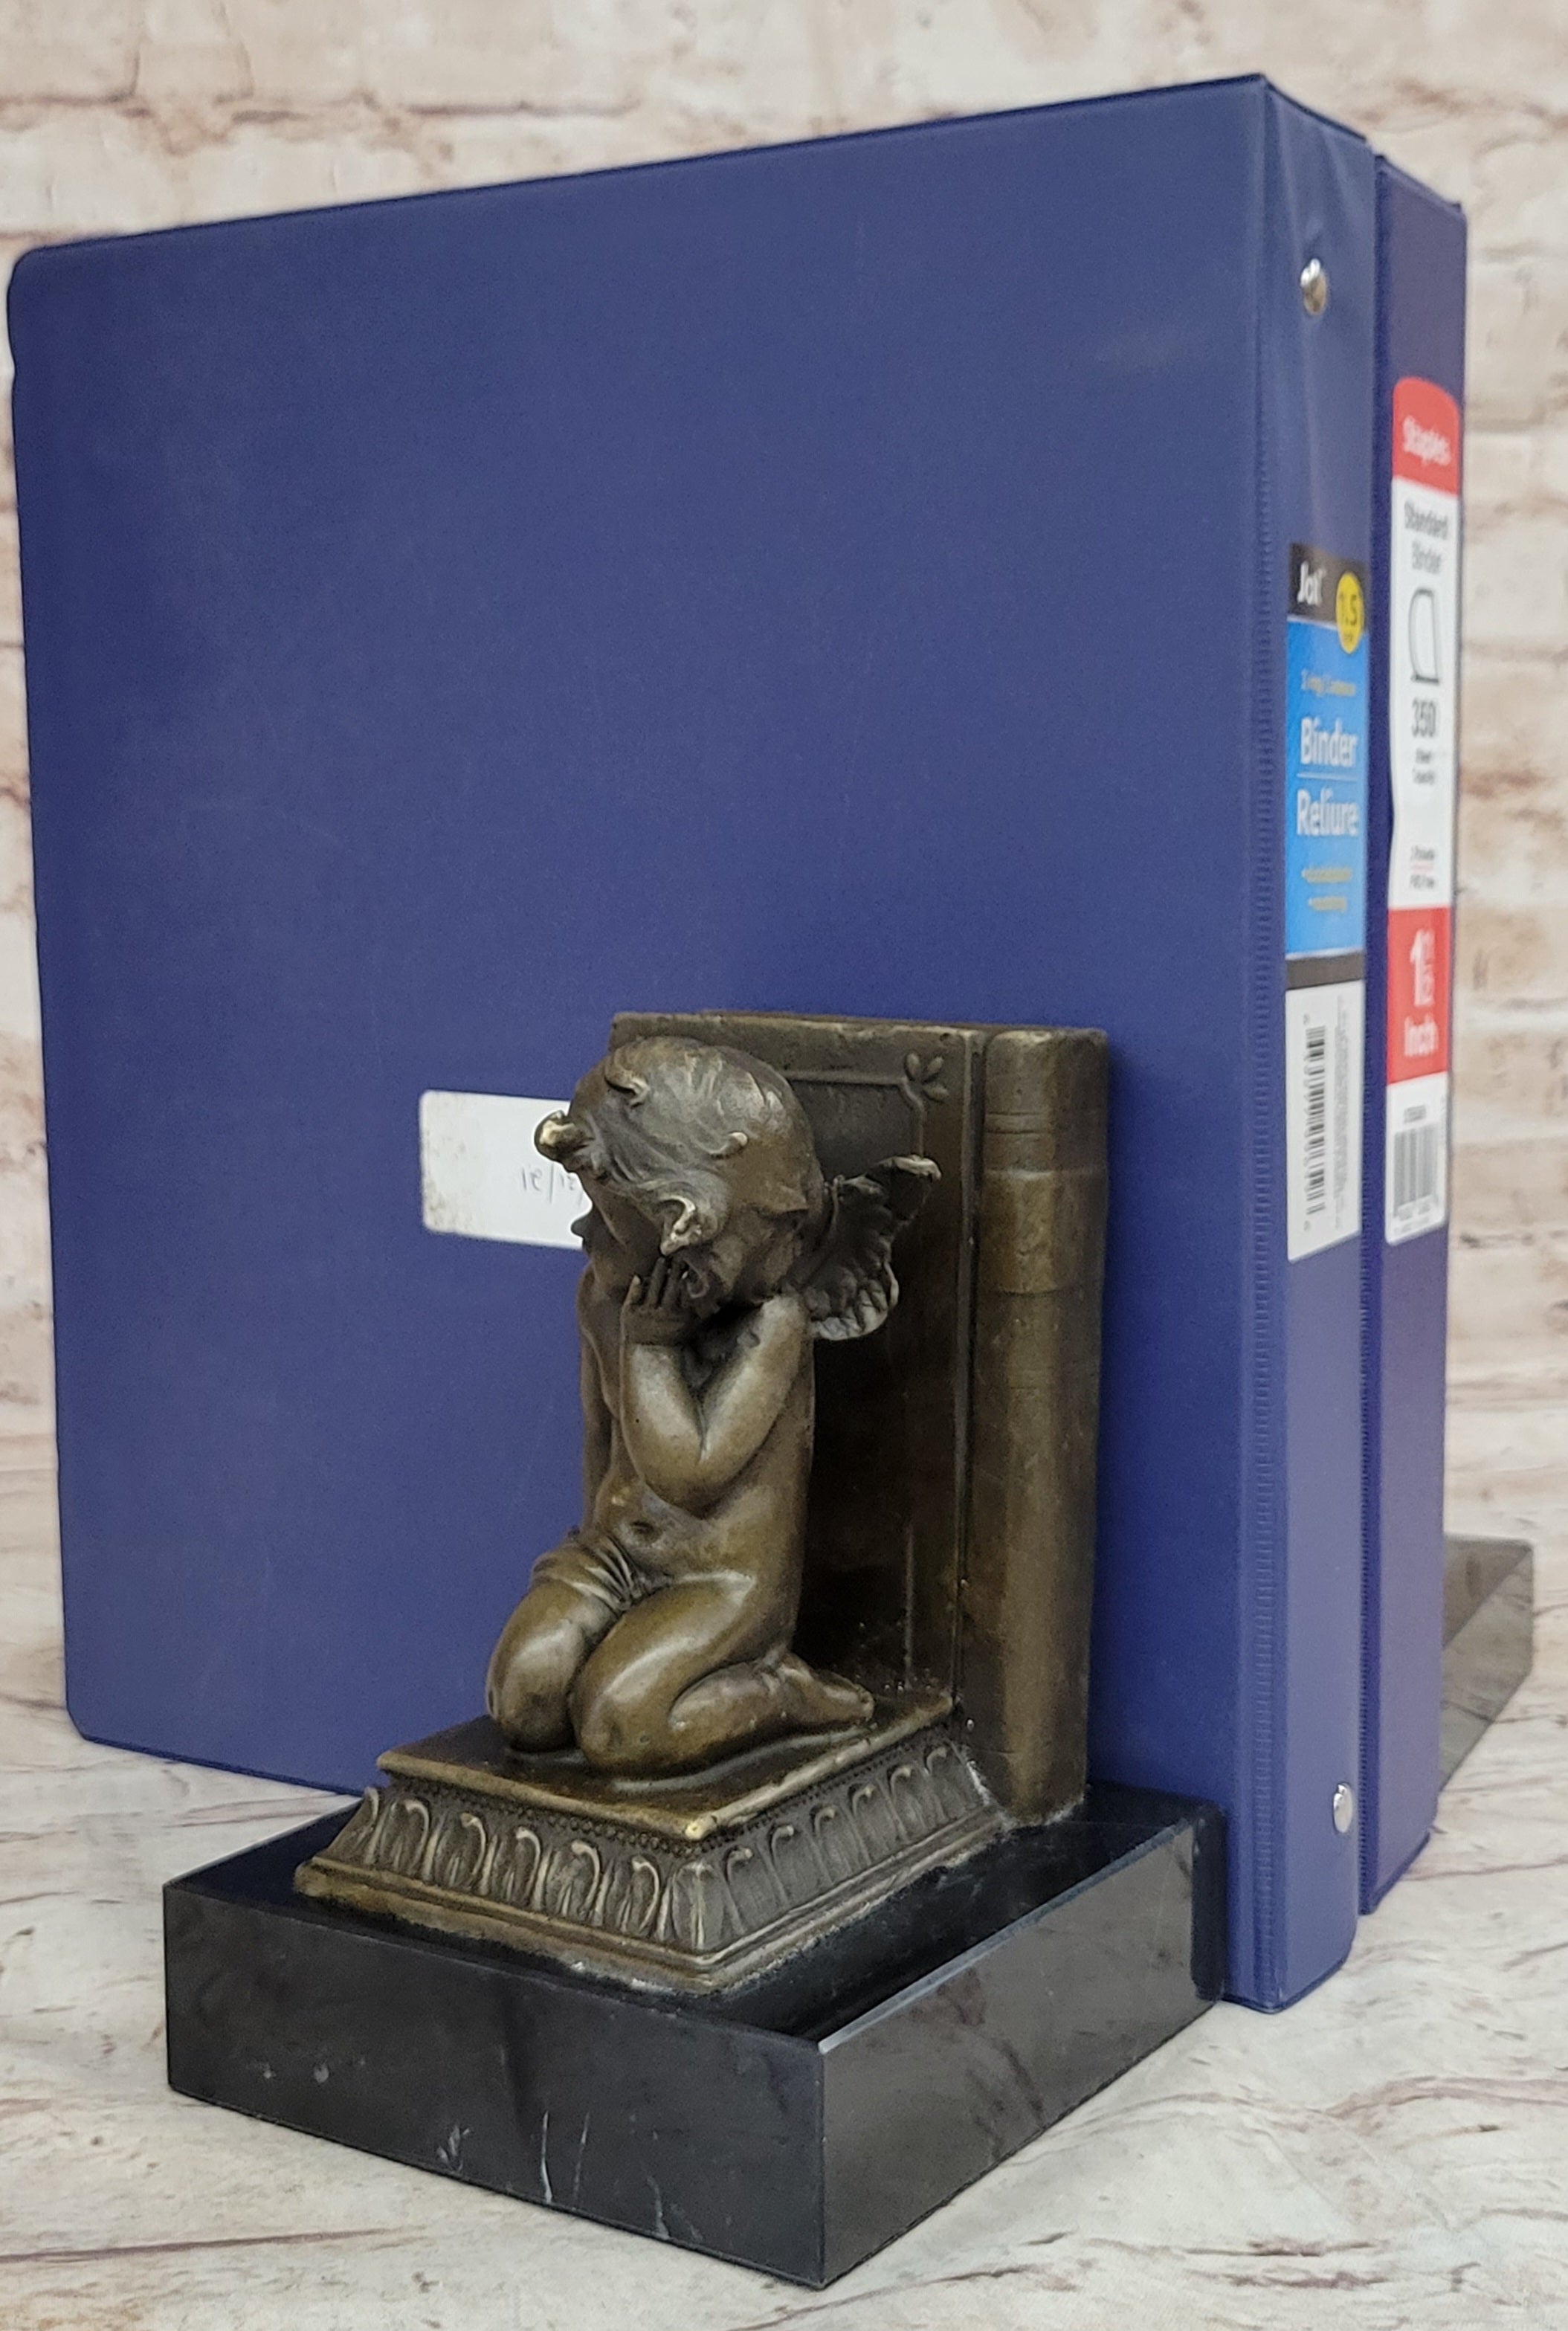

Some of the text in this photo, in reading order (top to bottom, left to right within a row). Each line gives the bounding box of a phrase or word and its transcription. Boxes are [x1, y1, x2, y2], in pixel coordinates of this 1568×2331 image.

[1403, 415, 1451, 466] Staples
[1300, 716, 1358, 768] Binder
[1413, 697, 1436, 738] 350
[1297, 787, 1359, 836] Reliure
